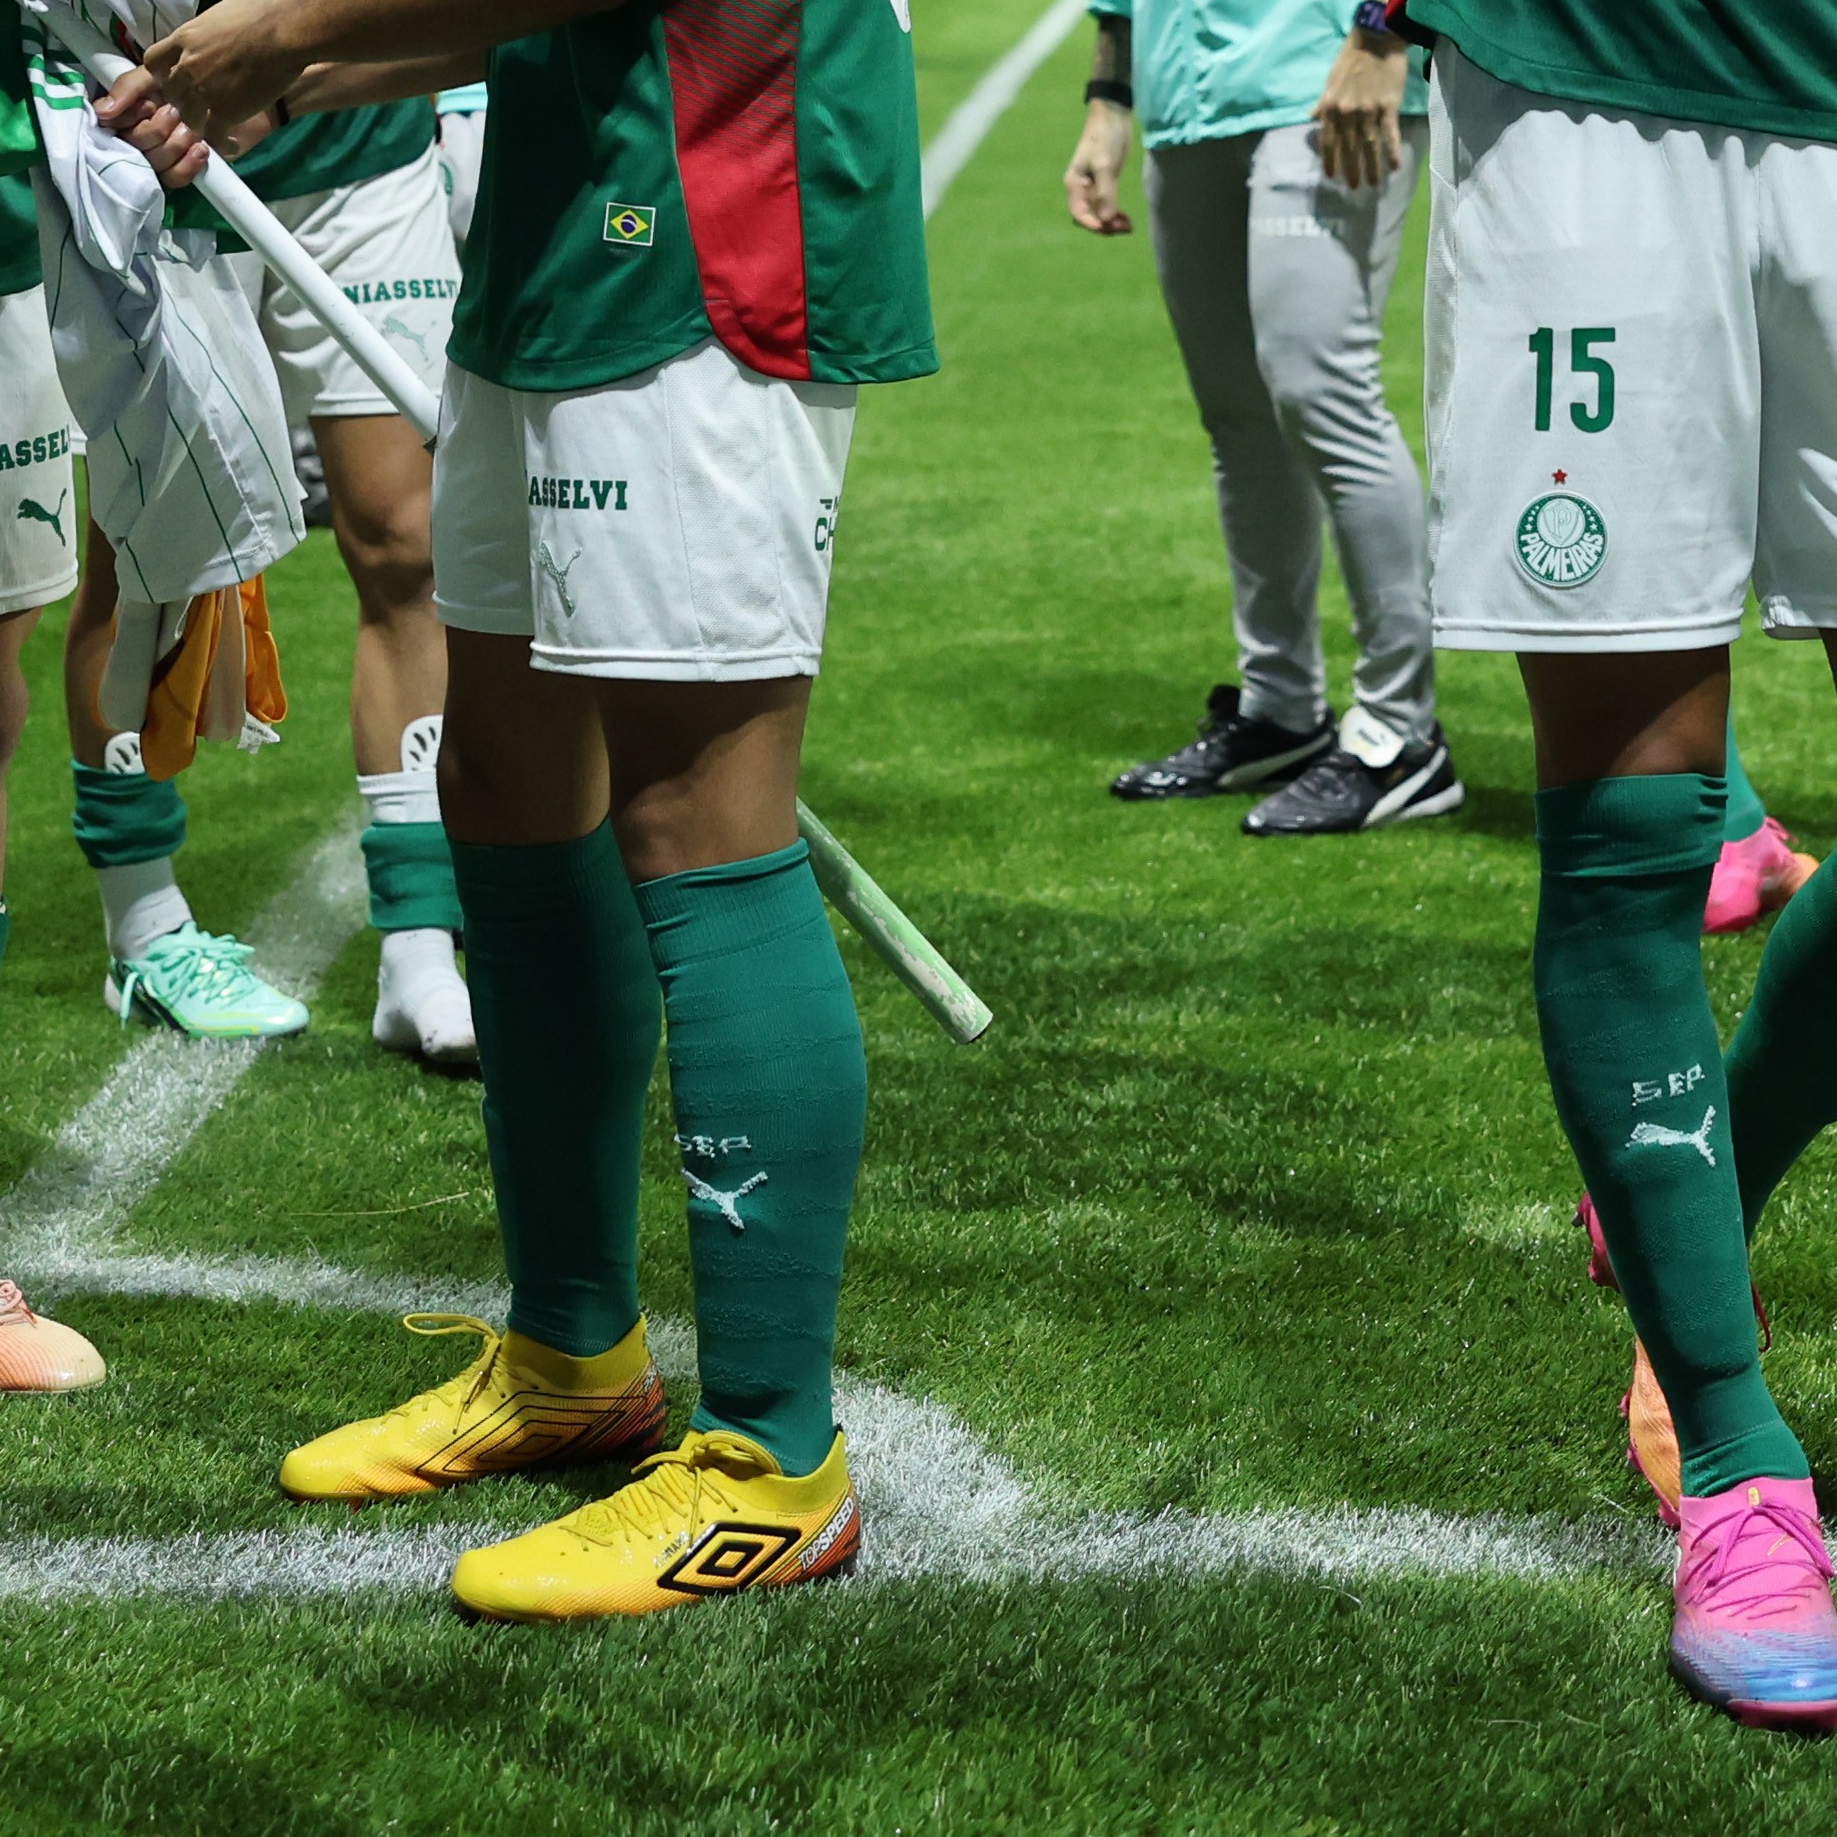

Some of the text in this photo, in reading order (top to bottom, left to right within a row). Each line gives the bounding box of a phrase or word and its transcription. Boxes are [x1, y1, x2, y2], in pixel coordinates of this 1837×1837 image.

[1528, 326, 1616, 433] 15
[527, 478, 628, 511] ASSELVI
[1520, 532, 1605, 581] PALMEIRAS
[798, 1496, 856, 1572] TOPSPEED
